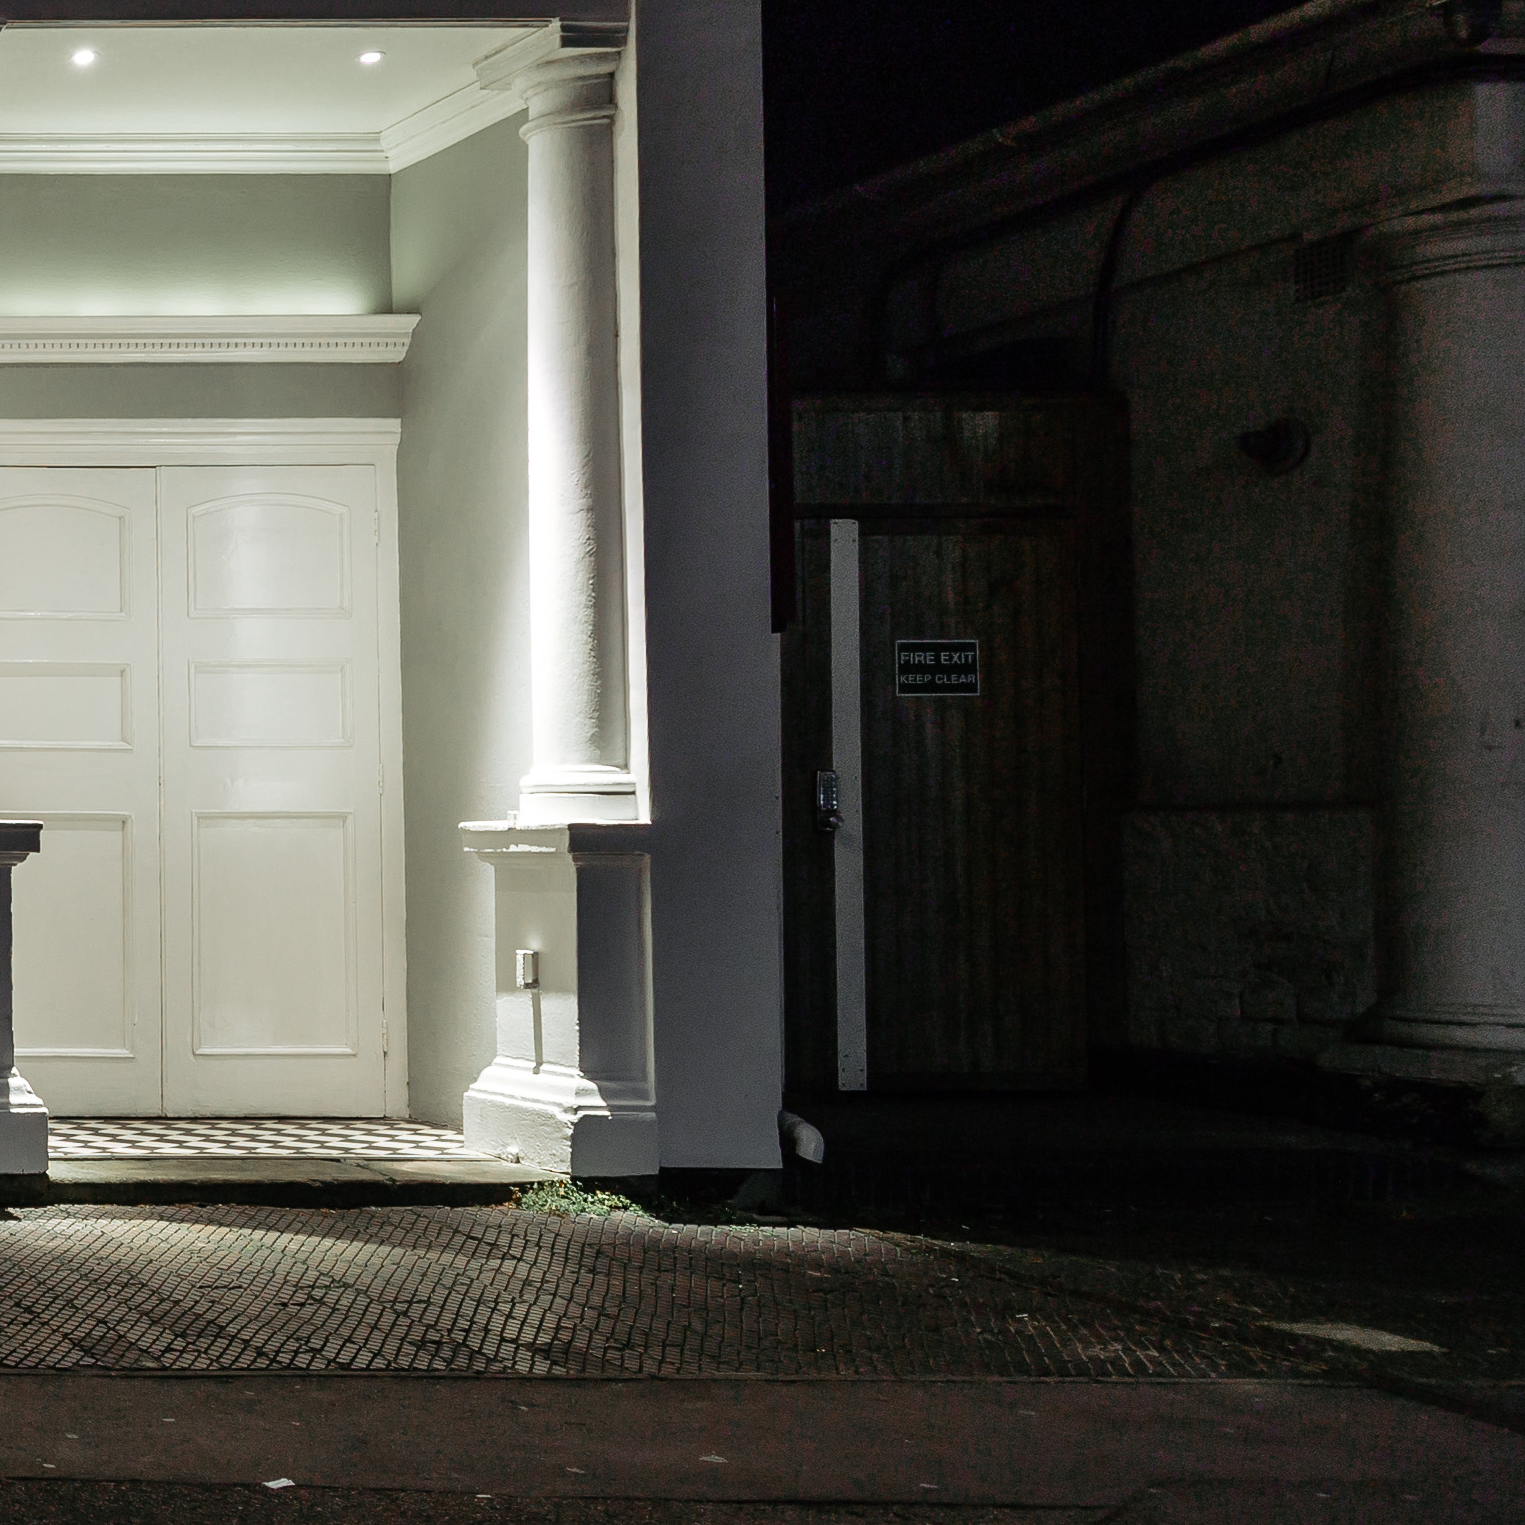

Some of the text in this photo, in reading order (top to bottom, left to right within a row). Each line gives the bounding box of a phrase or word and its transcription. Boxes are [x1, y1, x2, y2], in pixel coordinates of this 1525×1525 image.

[900, 651, 975, 664] FIRE EXIT
[899, 674, 975, 684] KEEP CLEAR
